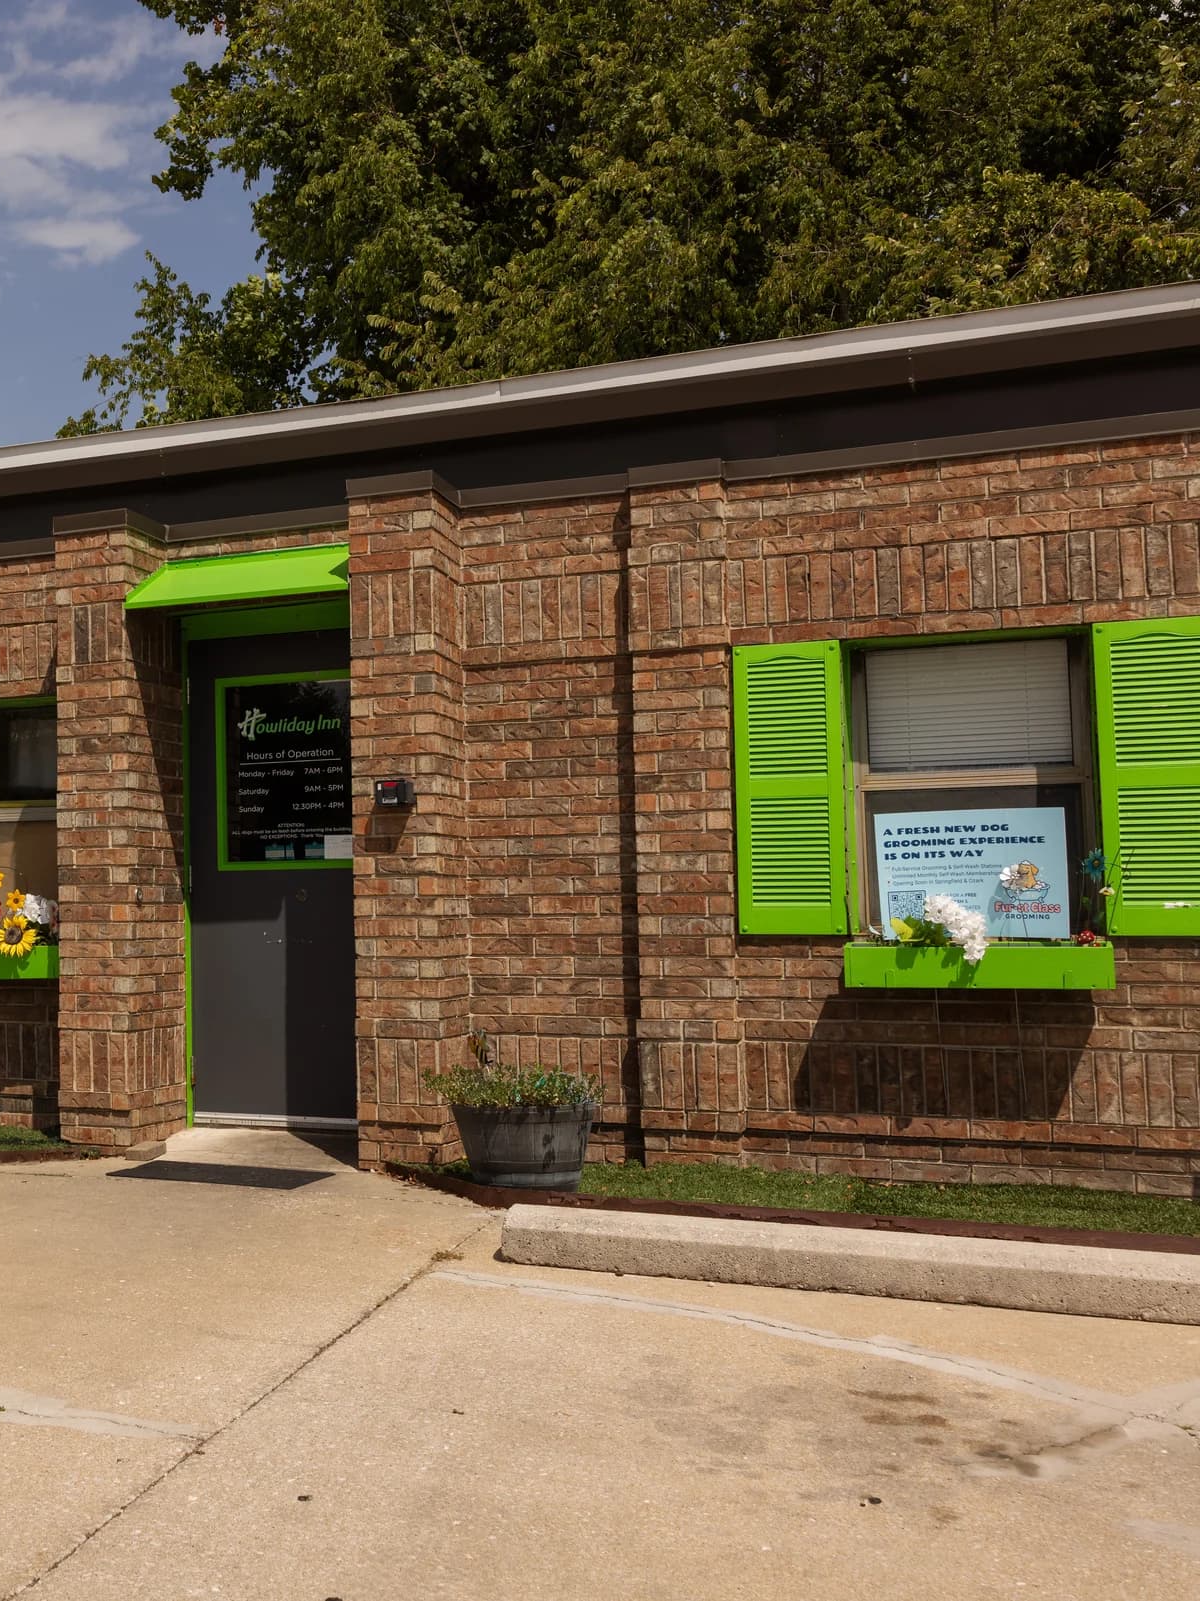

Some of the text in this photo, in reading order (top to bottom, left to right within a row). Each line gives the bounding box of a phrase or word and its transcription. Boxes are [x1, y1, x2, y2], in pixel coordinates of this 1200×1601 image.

[238, 708, 340, 740] Howliday Inn
[276, 750, 285, 758] of
[288, 748, 334, 758] Operation
[239, 788, 270, 796] Saturday
[897, 826, 940, 836] FRESH
[945, 825, 976, 833] NEW
[981, 824, 1009, 832] DOG
[884, 836, 1046, 848] GROOMING EXPERIENCE
[884, 849, 984, 861] IS ON ITS WAY
[1030, 902, 1062, 913] Class
